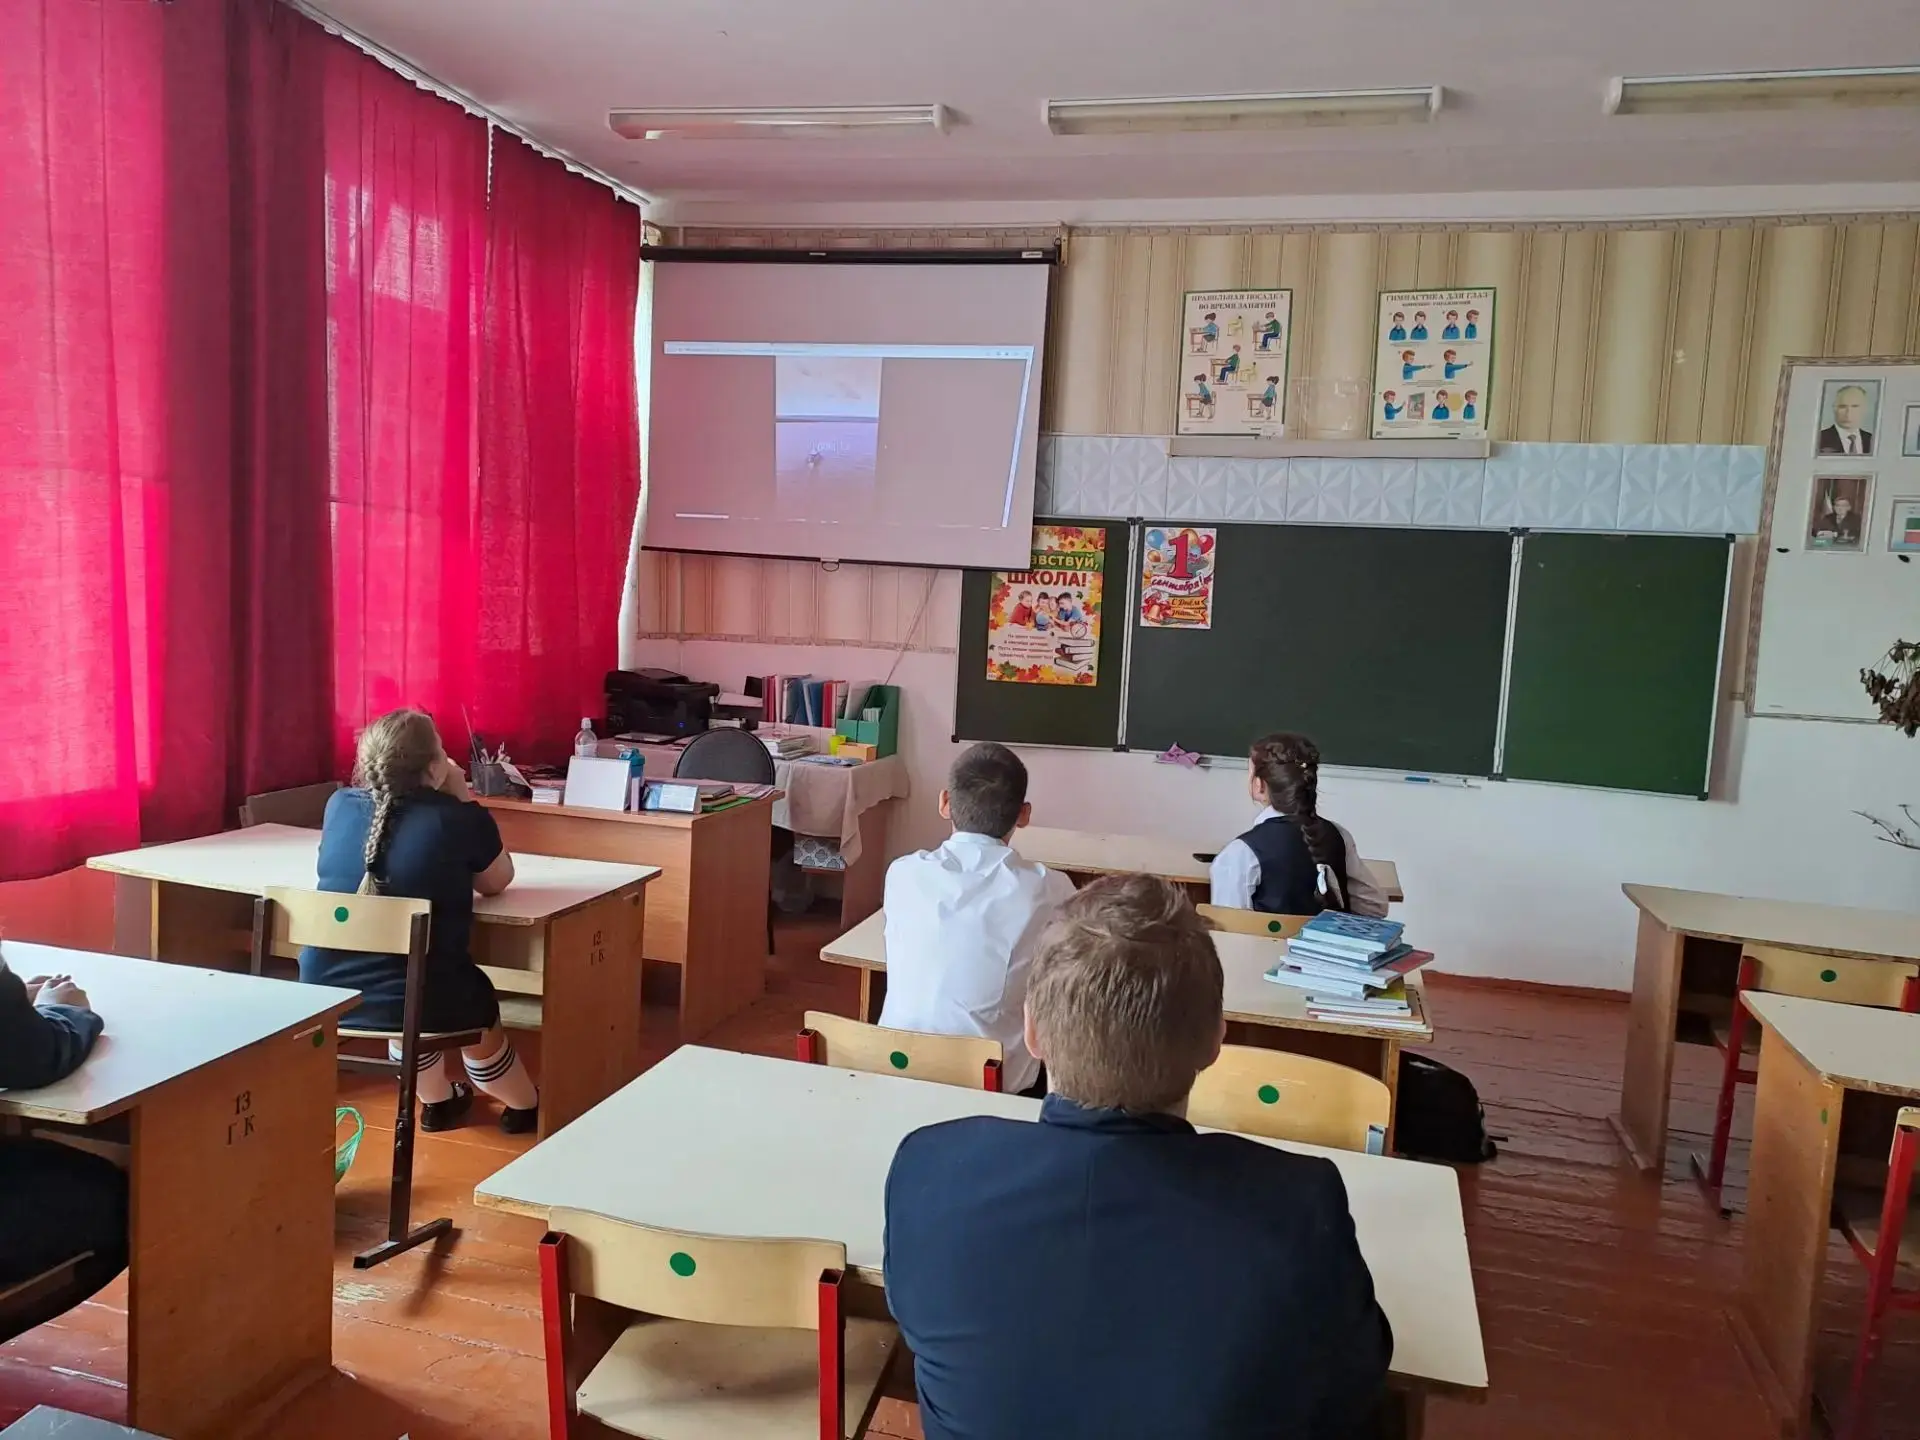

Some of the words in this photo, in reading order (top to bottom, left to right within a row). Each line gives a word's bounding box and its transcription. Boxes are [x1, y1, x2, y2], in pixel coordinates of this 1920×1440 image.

[1168, 534, 1193, 578] 1
[1007, 570, 1087, 587] ШКОЛА!
[235, 1090, 251, 1114] 13
